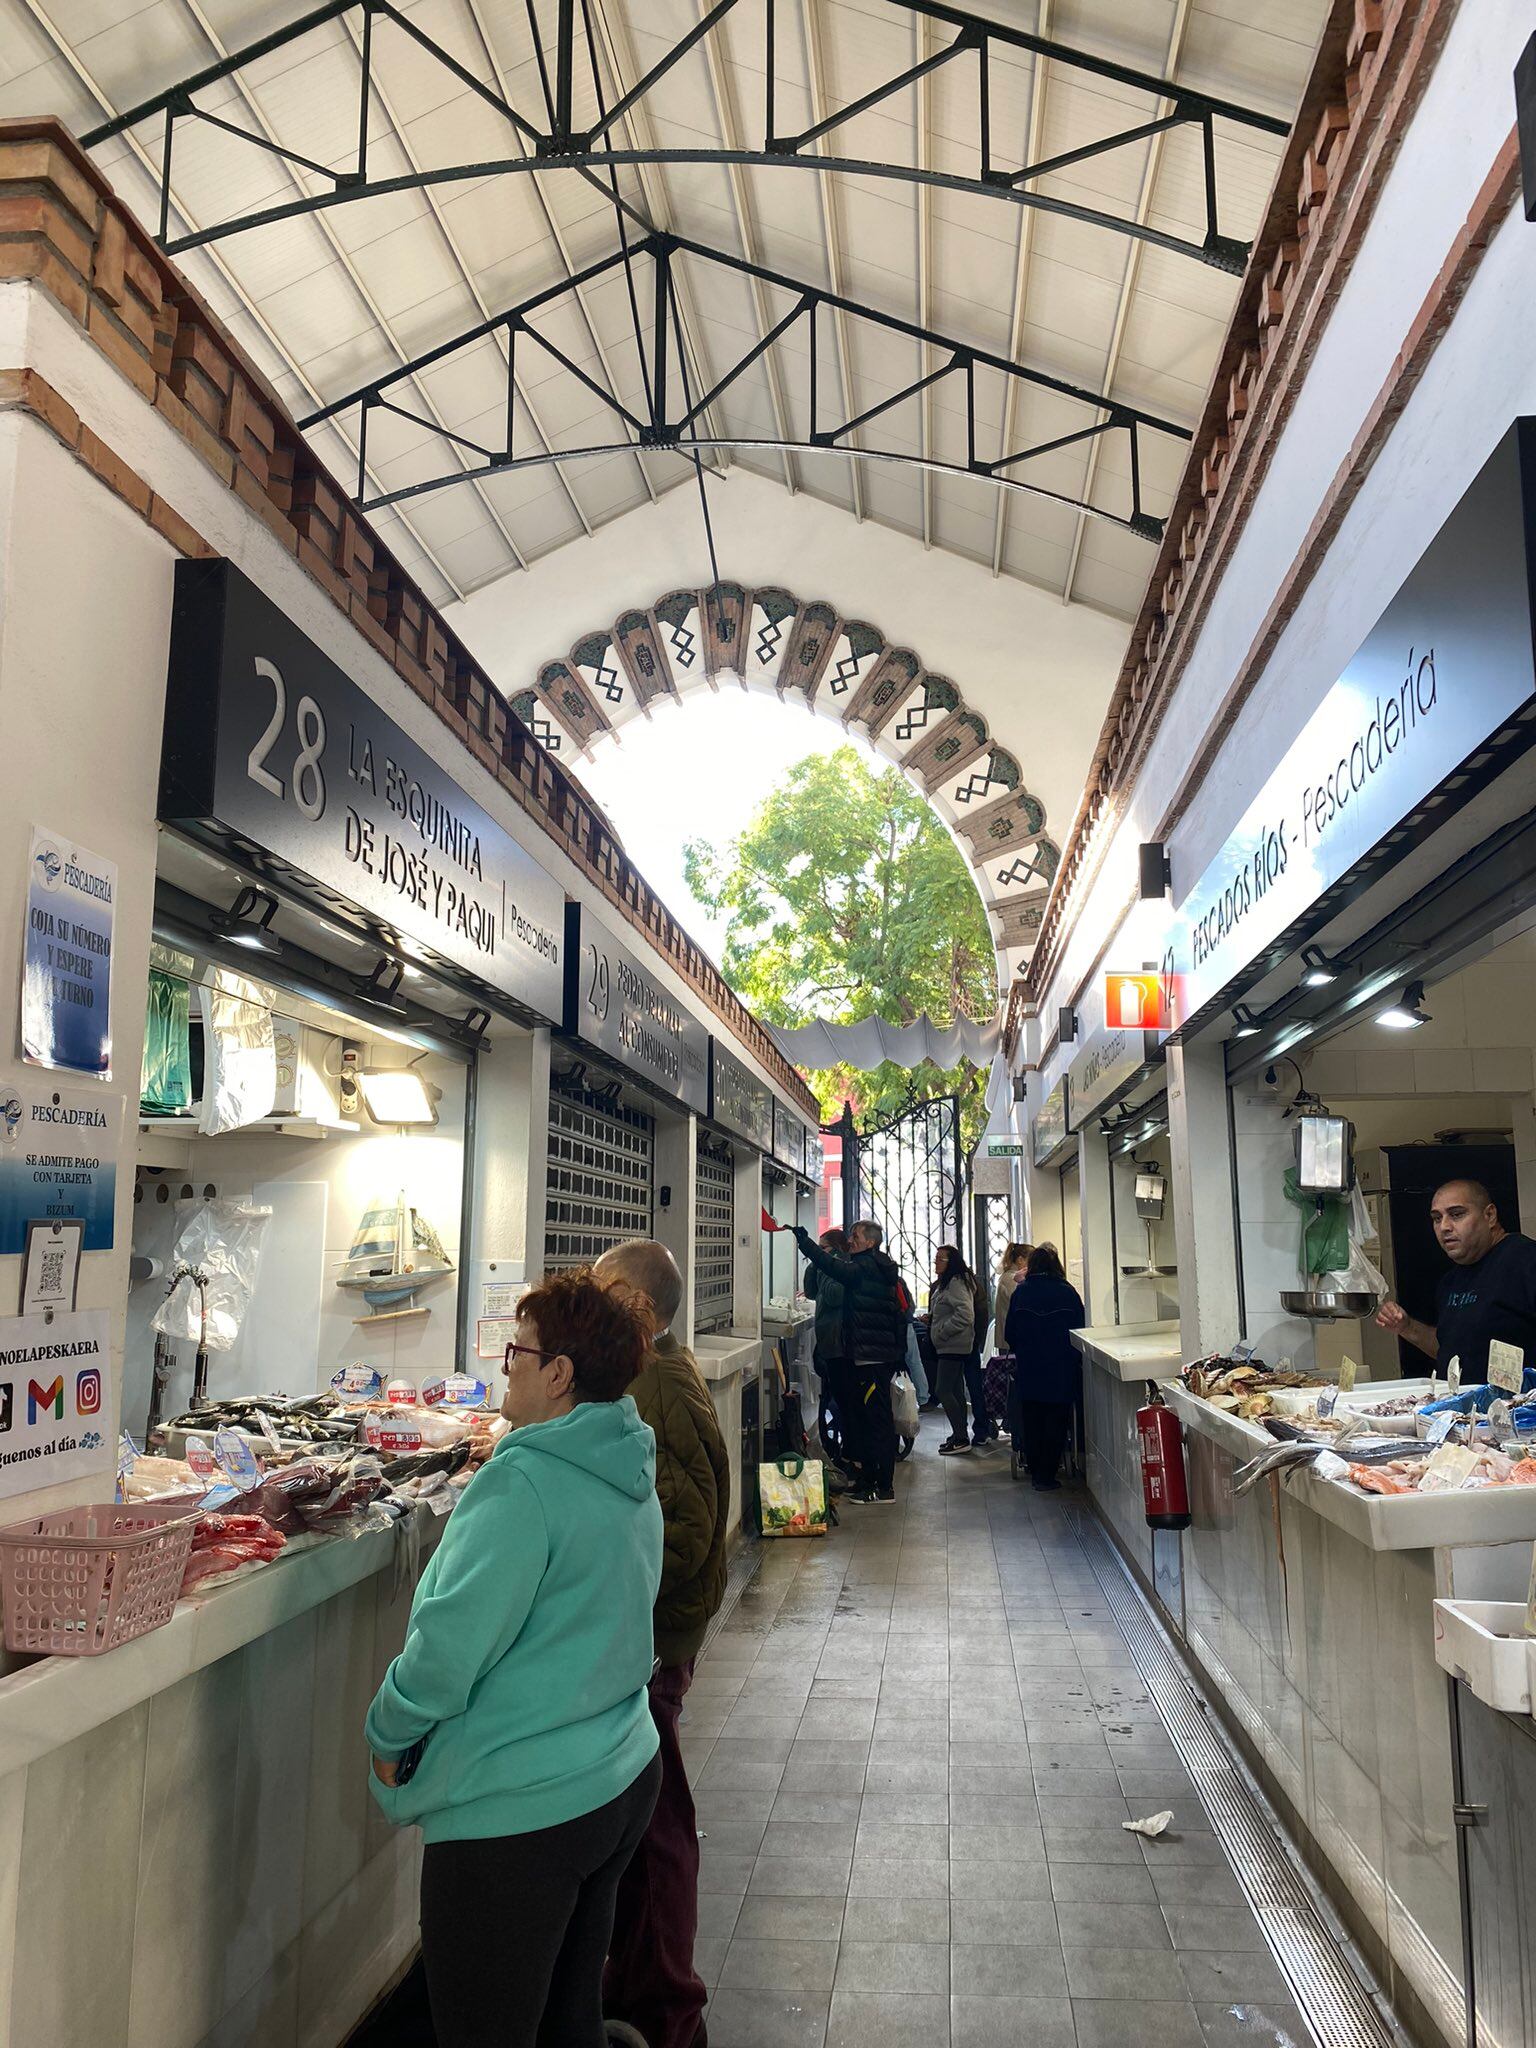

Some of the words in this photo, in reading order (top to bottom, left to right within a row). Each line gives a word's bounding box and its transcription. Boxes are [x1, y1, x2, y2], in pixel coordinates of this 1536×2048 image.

[247, 656, 328, 822] 28
[348, 724, 377, 797] LA
[385, 757, 483, 882] ESQUINITA
[1193, 864, 1251, 970] PESCADOS
[1254, 819, 1288, 903] RÍOS
[1303, 646, 1438, 848] Pescadería
[63, 863, 112, 904] PESCADERÍA
[345, 805, 375, 875] DE
[378, 834, 428, 911] JOSÉ
[432, 870, 444, 919] Y
[447, 882, 495, 955] PAQUI
[31, 907, 54, 937] COJA
[57, 918, 70, 941] SU
[72, 924, 110, 958] NÚMERO
[47, 944, 54, 965] Y
[57, 947, 93, 980] ESPERE
[61, 979, 94, 1009] TURNO
[587, 944, 610, 1021] 29
[617, 959, 644, 1011] PEDRO
[31, 1105, 107, 1128] PESCADERÍA
[25, 1154, 38, 1166] SE
[38, 1156, 74, 1169] ADMITE
[75, 1157, 100, 1170] PAGO
[989, 1146, 1023, 1156] SALIDA
[33, 1171, 52, 1183] CON
[53, 1172, 92, 1185] TARJETA
[57, 1188, 64, 1200] Y
[46, 1204, 74, 1216] BIZUM
[43, 1440, 56, 1455] al
[58, 1435, 77, 1452] día
